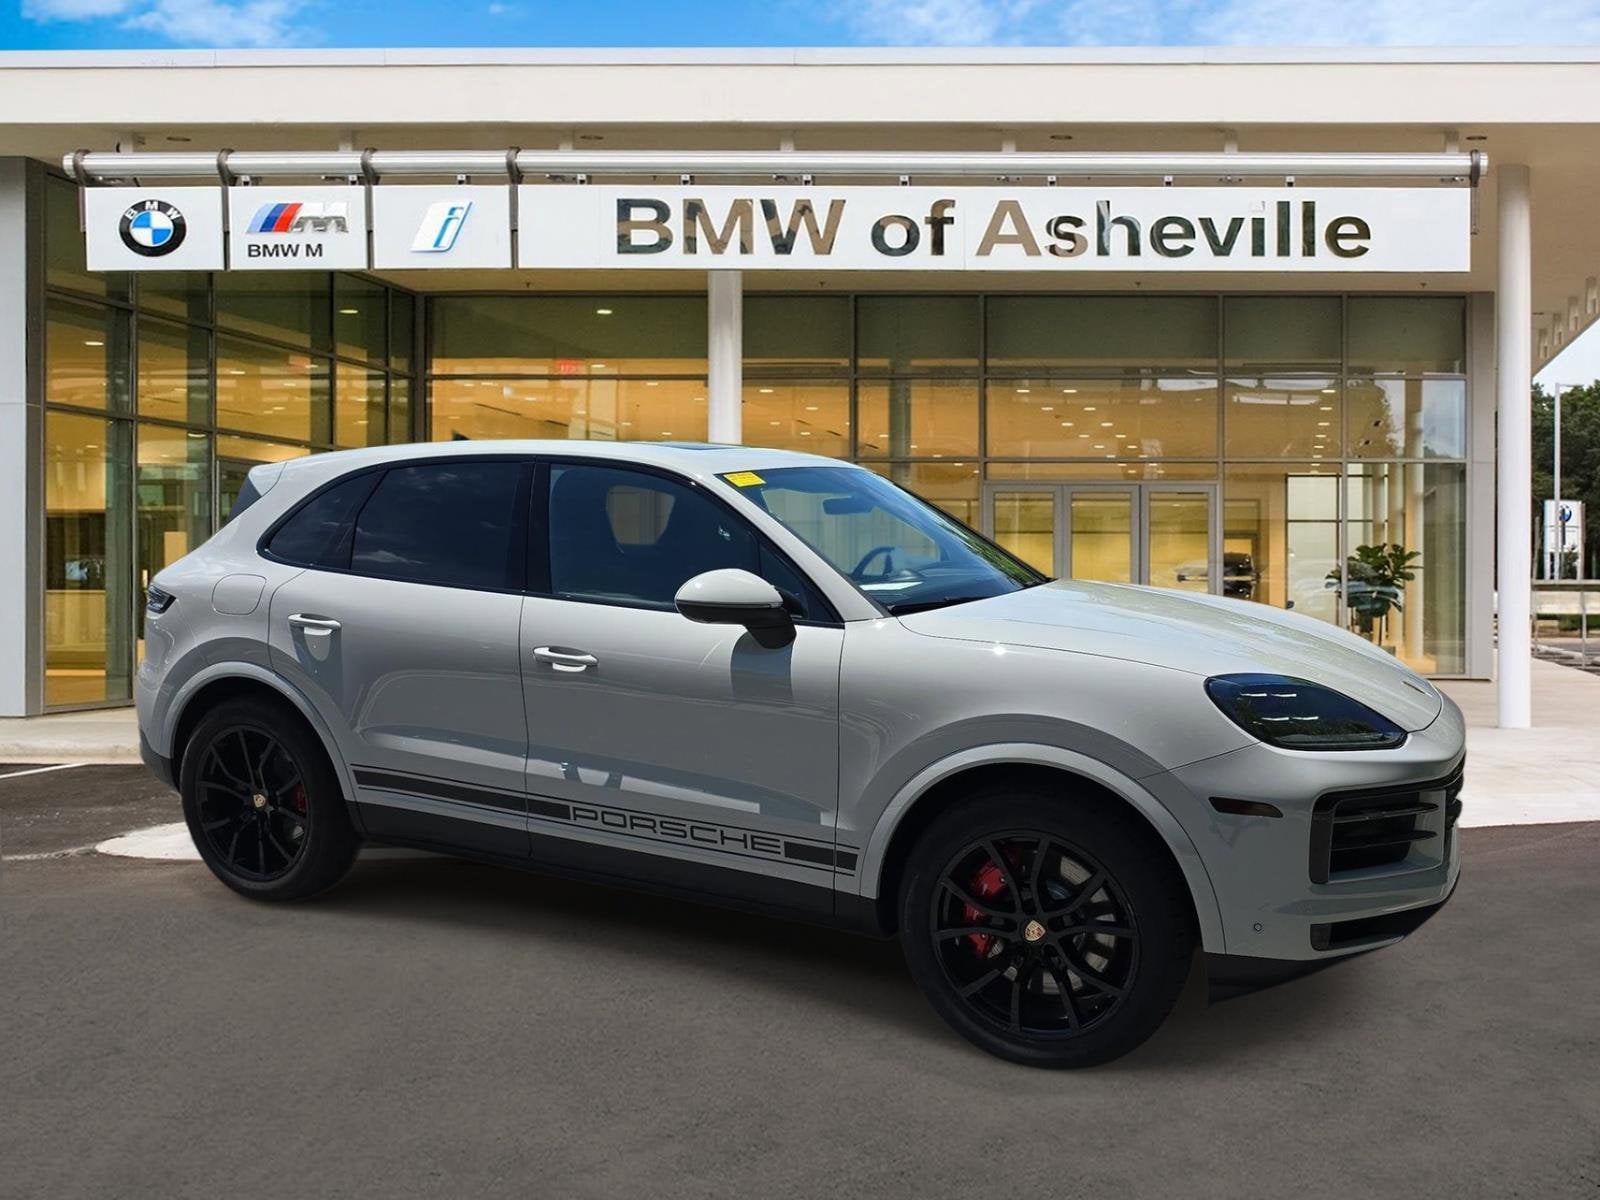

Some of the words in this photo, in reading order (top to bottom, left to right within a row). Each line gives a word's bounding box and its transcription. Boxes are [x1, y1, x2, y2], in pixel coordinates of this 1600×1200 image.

[125, 200, 181, 220] BMW
[616, 199, 846, 256] BMW
[871, 199, 956, 257] of
[977, 199, 1372, 258] Asheville
[247, 244, 300, 258] BMW
[305, 244, 323, 258] M
[571, 806, 782, 856] PORSCHE
